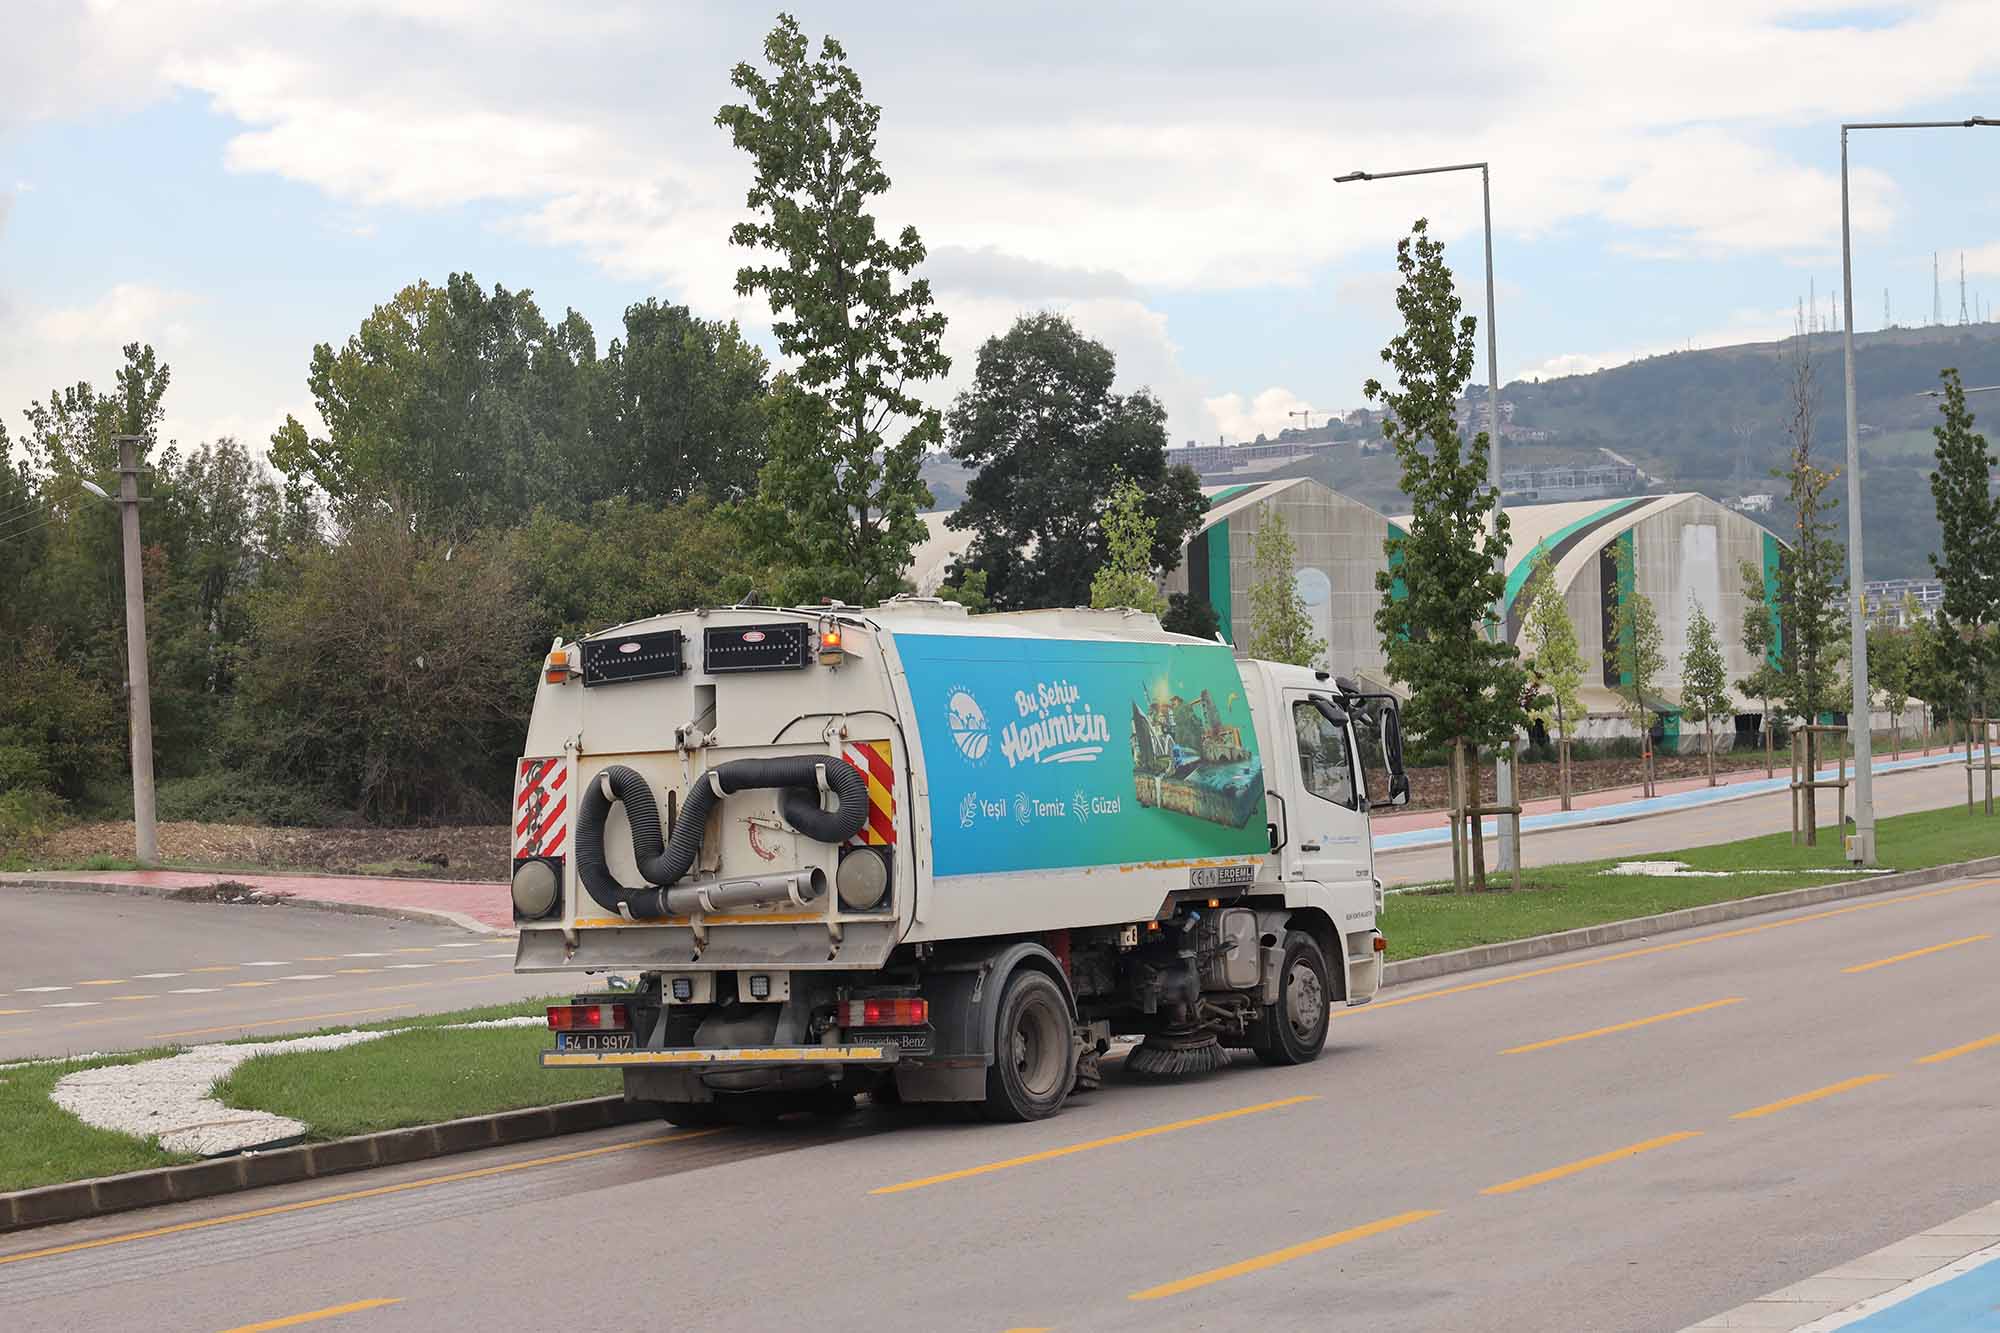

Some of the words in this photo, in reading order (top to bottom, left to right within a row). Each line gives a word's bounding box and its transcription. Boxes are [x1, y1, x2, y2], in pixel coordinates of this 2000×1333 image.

[1015, 690, 1038, 717] Bu
[1038, 679, 1080, 716] Şehir
[1001, 703, 1110, 768] Hepimizin
[979, 799, 1007, 821] Yeşil
[1032, 798, 1066, 817] Temiz
[1091, 797, 1121, 815] Güzel
[566, 1035, 581, 1050] 54
[587, 1035, 597, 1050] D
[602, 1035, 631, 1050] 9917
[854, 1035, 927, 1049] Mercedes-Benz
